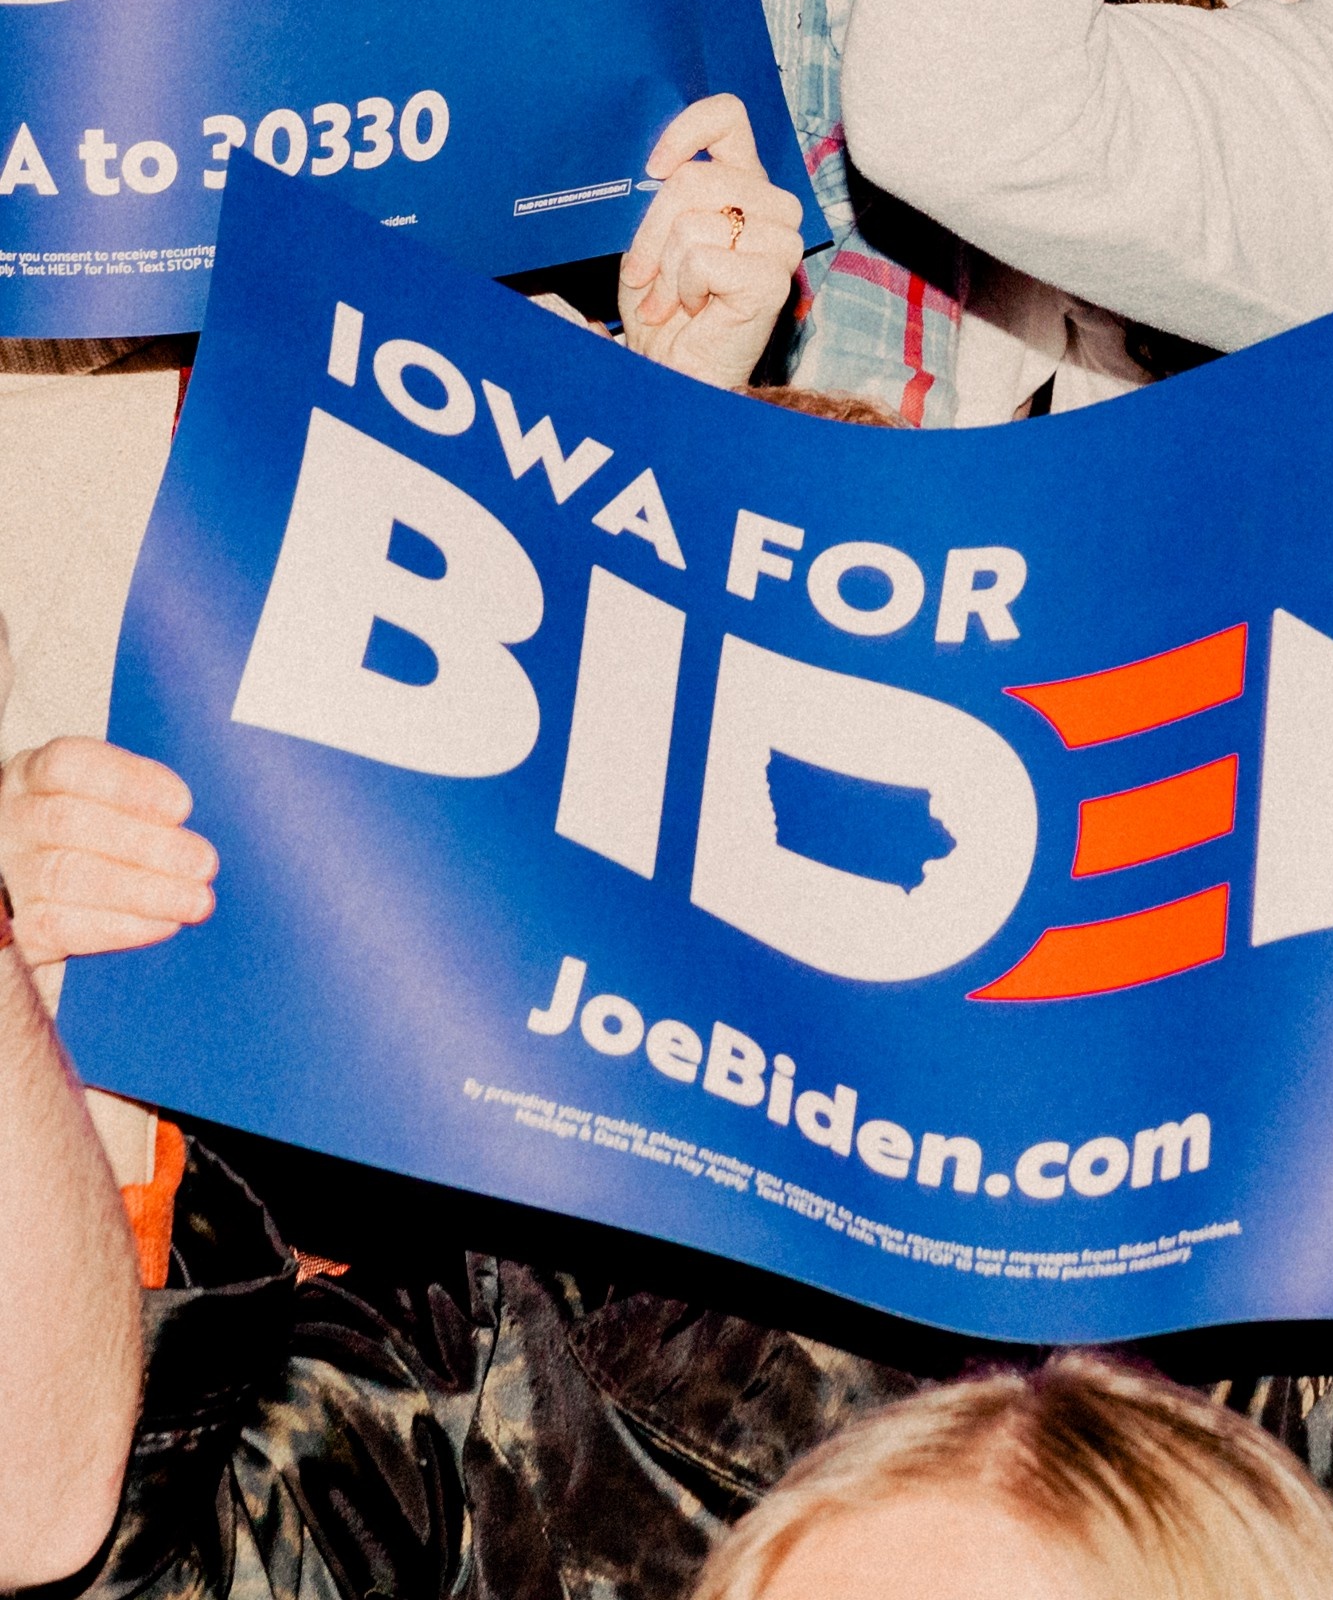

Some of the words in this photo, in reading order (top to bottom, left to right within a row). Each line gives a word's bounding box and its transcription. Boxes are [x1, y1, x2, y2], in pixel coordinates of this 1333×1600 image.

[80, 127, 178, 197] to
[201, 90, 451, 191] 30330
[19, 253, 40, 265] you
[43, 251, 92, 262] consent
[94, 250, 108, 261] to
[112, 247, 157, 260] receive
[161, 244, 216, 259] recurring
[22, 262, 45, 274] Text
[48, 262, 81, 274] HELP
[84, 262, 103, 274] for
[138, 259, 164, 272] Text
[167, 257, 201, 270] STOP
[328, 301, 687, 570] IOWA
[725, 509, 1028, 645] FOR
[527, 955, 1211, 1199] JoeBiden.com
